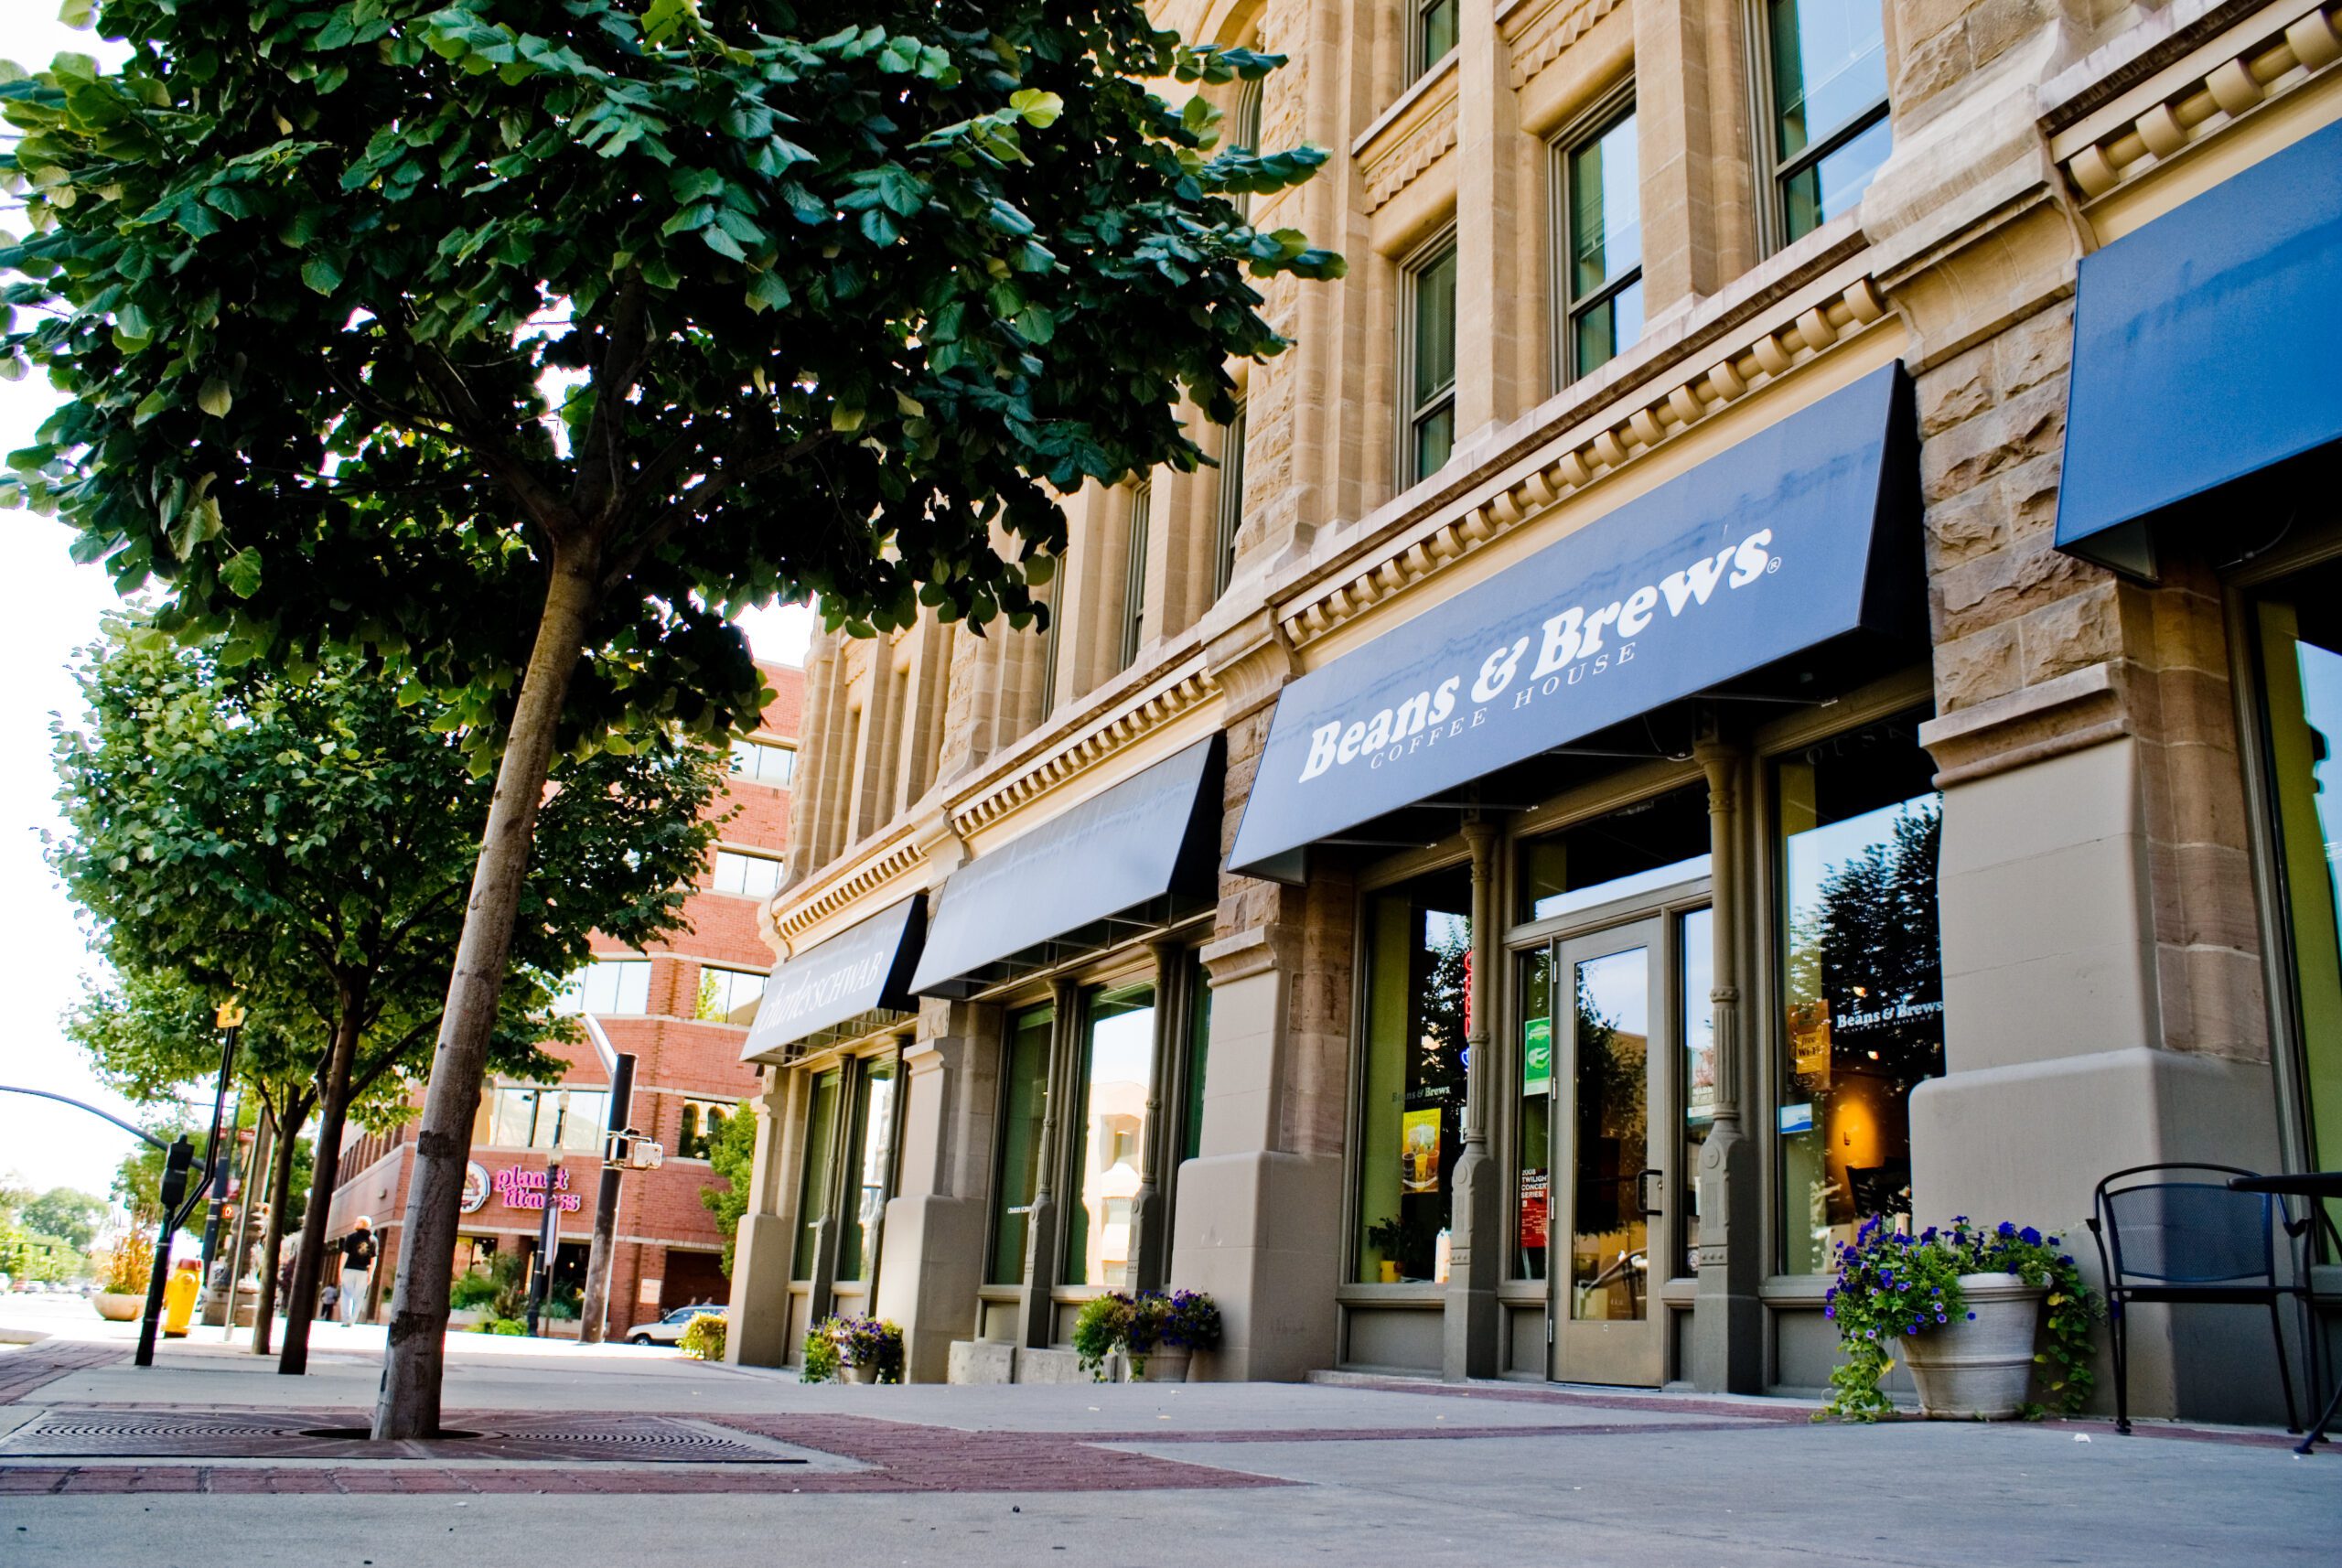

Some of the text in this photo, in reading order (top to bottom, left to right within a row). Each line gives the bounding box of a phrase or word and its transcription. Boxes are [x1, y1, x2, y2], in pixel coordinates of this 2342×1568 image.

[1298, 528, 1773, 783] Beans & Brews
[1370, 641, 1638, 770] COFFEE HOUSE
[1837, 1001, 1943, 1028] Beans & Brews
[1424, 1086, 1450, 1097] Brews
[494, 1165, 569, 1192] plant
[1521, 1175, 1548, 1183] TWILIGH
[502, 1187, 581, 1212] fitnss
